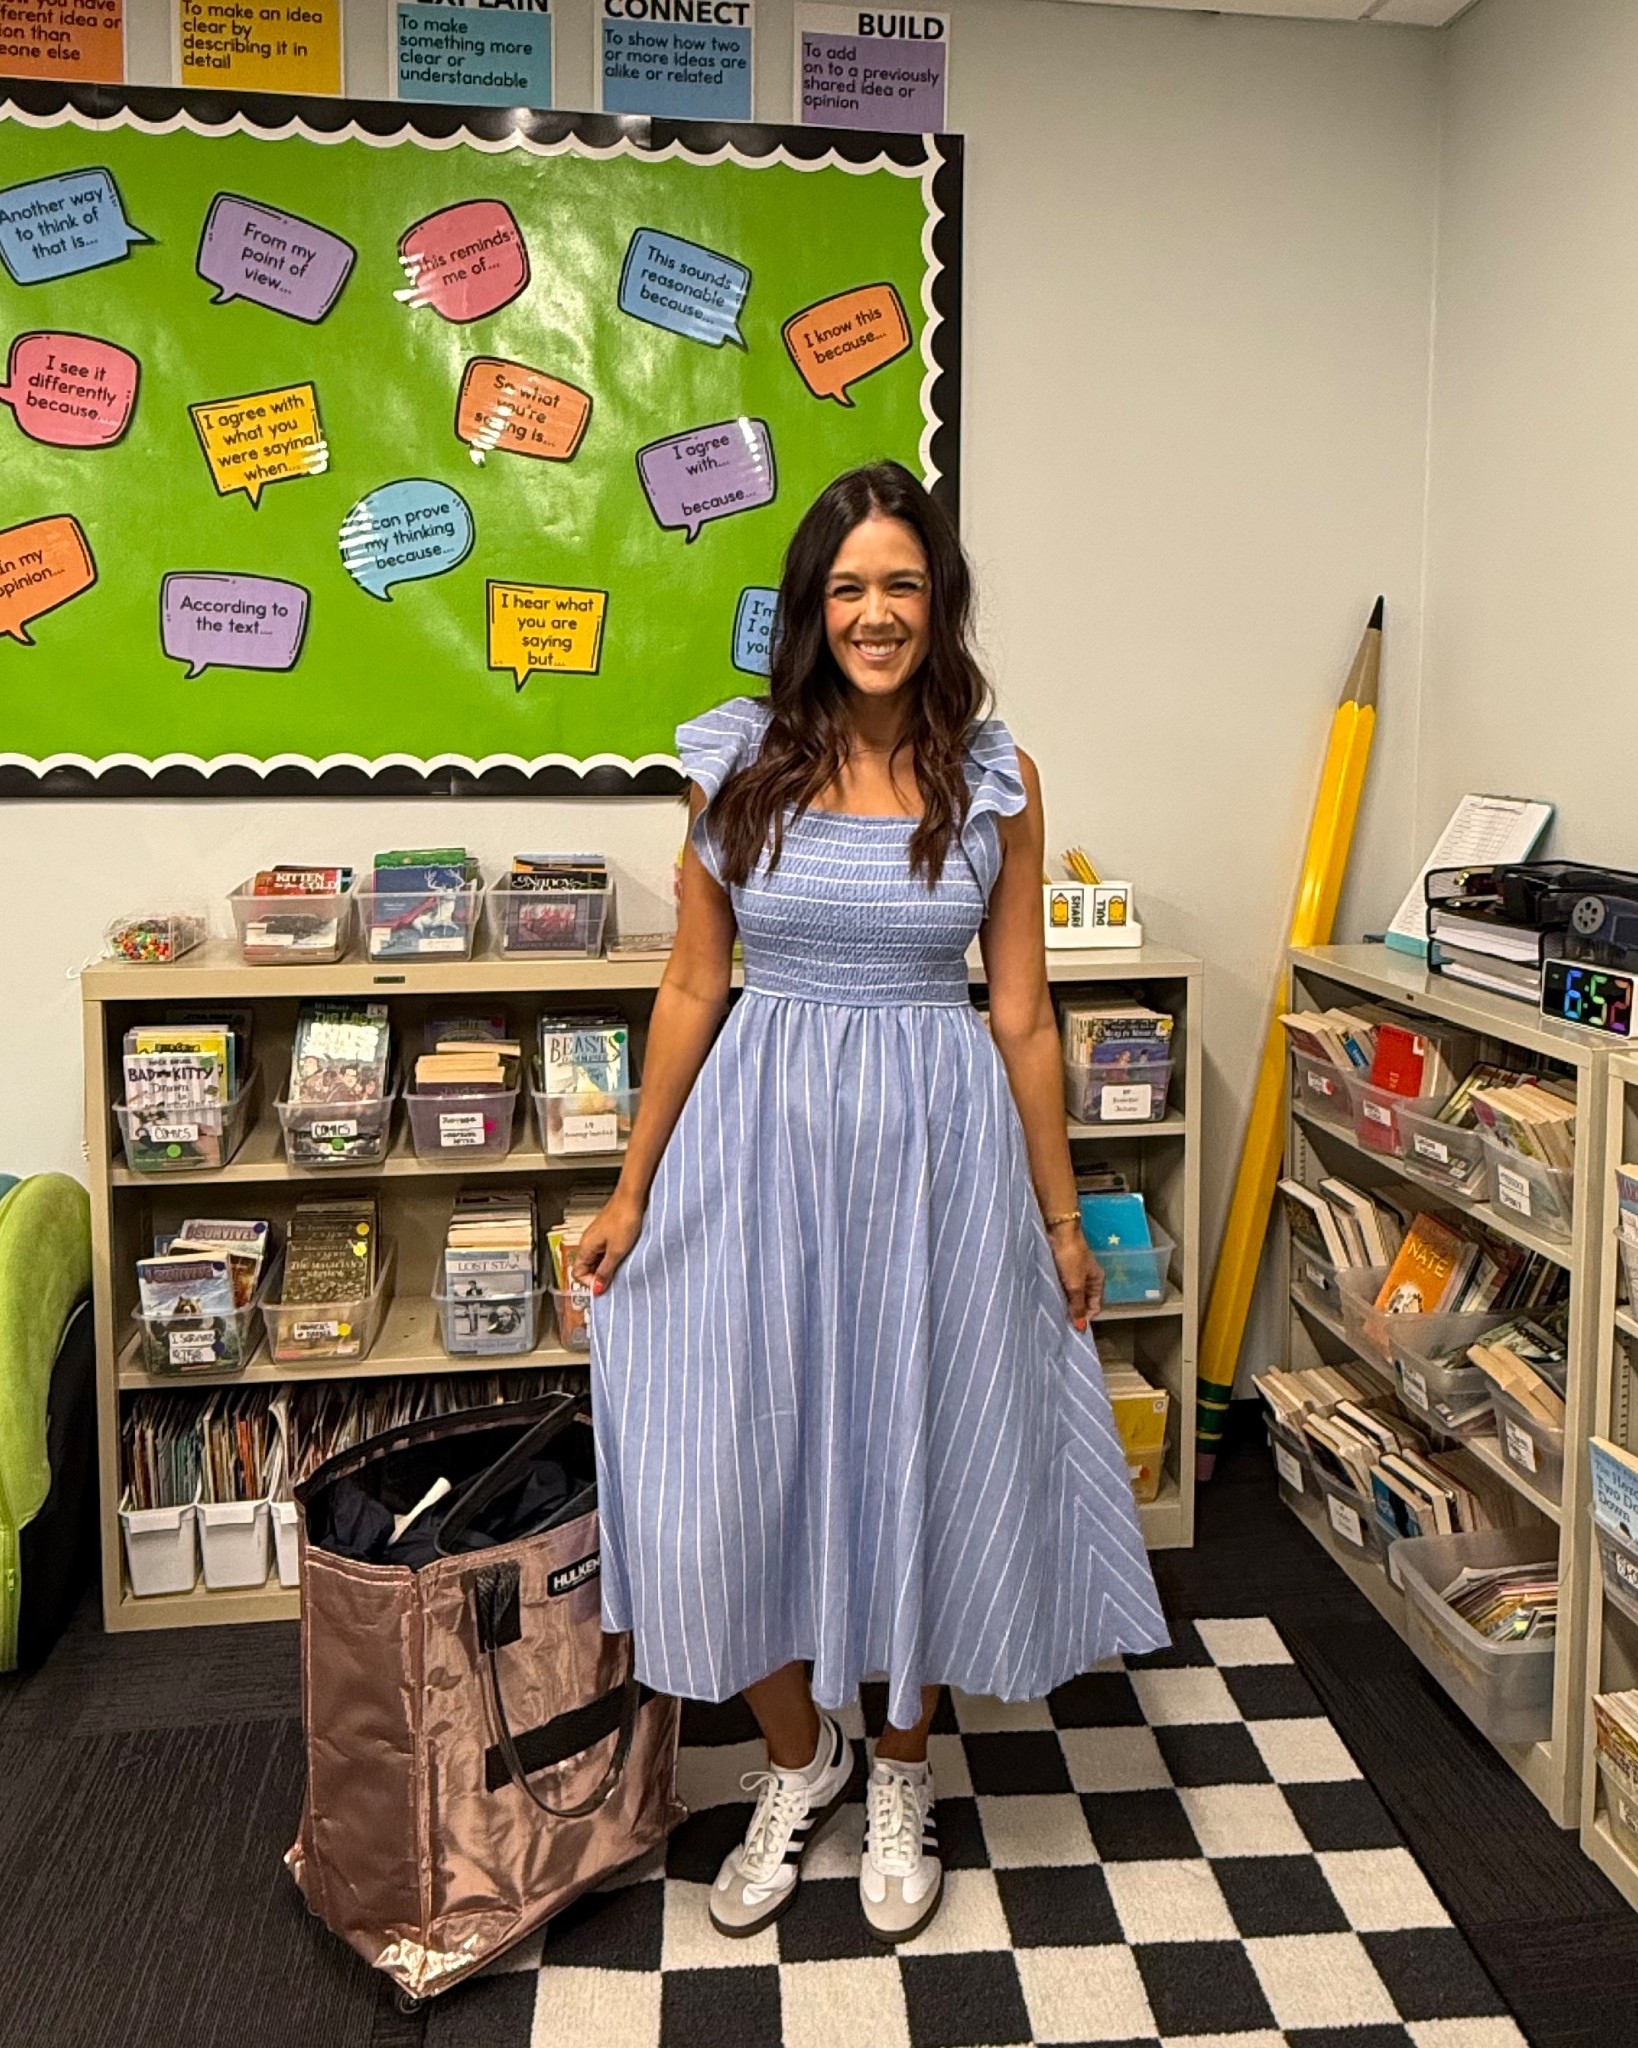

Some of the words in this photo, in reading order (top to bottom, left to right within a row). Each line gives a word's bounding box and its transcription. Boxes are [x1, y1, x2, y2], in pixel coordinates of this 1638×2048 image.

[59, 10, 98, 27] idea
[103, 18, 122, 28] or
[183, 0, 202, 15] To
[208, 3, 254, 19] make
[259, 9, 281, 21] an
[287, 6, 323, 24] idea
[399, 13, 419, 30] To
[424, 17, 469, 34] make
[604, 0, 750, 26] CONNECT
[31, 24, 71, 42] than
[183, 16, 227, 34] clear
[232, 19, 253, 40] by
[858, 12, 945, 40] BUILD
[47, 43, 80, 61] else
[183, 33, 272, 59] describing
[276, 40, 288, 56] it
[293, 42, 308, 57] in
[399, 34, 485, 56] something
[490, 41, 533, 56] more
[604, 28, 623, 45] To
[628, 30, 669, 49] show
[673, 33, 706, 51] how
[712, 37, 741, 53] two
[804, 42, 821, 58] To
[826, 47, 857, 61] add
[183, 51, 231, 69] detail
[399, 49, 443, 66] clear
[447, 55, 466, 67] or
[604, 50, 623, 62] or
[626, 51, 669, 66] more
[674, 51, 716, 68] ideas
[720, 58, 747, 70] are
[400, 67, 529, 89] understandable
[604, 63, 640, 79] alike
[645, 69, 664, 82] or
[667, 68, 723, 85] related
[803, 62, 824, 75] on
[828, 61, 843, 77] to
[848, 66, 858, 78] a
[863, 67, 939, 88] previously
[803, 76, 857, 94] shared
[861, 80, 894, 97] idea
[898, 88, 916, 98] or
[803, 93, 859, 110] opinion
[0, 199, 65, 223] Another
[69, 188, 103, 206] way
[15, 228, 34, 242] to
[38, 213, 79, 236] think
[83, 206, 99, 224] of
[32, 240, 67, 259] that
[243, 222, 287, 251] From
[291, 244, 317, 263] my
[449, 230, 511, 261] reminds
[242, 247, 285, 270] point
[289, 263, 309, 279] of
[648, 245, 676, 270] This
[679, 263, 732, 290] sounds
[442, 269, 467, 286] me
[641, 268, 725, 307] reasonable
[804, 333, 814, 348] I
[813, 320, 852, 344] know
[855, 308, 882, 326] this
[46, 354, 55, 371] I
[59, 362, 89, 378] see
[94, 366, 107, 382] it
[28, 373, 117, 407] differently
[520, 386, 560, 408] what
[203, 414, 214, 430] I
[218, 406, 267, 429] agree
[270, 394, 305, 414] with
[223, 424, 263, 446] what
[268, 418, 298, 440] you
[474, 412, 527, 441] sang
[217, 449, 258, 467] were
[672, 445, 682, 460] I
[685, 435, 730, 457] agree
[371, 515, 401, 531] can
[405, 503, 450, 527] prove
[365, 537, 389, 553] my
[393, 522, 455, 545] thinking
[18, 549, 43, 567] my
[180, 595, 267, 619] According
[271, 602, 289, 617] to
[501, 593, 509, 608] I
[513, 594, 551, 609] hear
[555, 596, 594, 612] what
[196, 616, 223, 632] the
[517, 617, 546, 632] you
[551, 618, 578, 630] are
[747, 618, 757, 632] I
[521, 635, 572, 653] saying
[276, 872, 325, 882] KITTEN
[1096, 899, 1106, 926] DULL
[1564, 969, 1631, 1033] 6:52
[550, 1035, 621, 1064] BEASTS
[128, 1067, 155, 1082] BAD
[172, 1066, 214, 1081] KITTY
[1407, 1241, 1449, 1278] NATE
